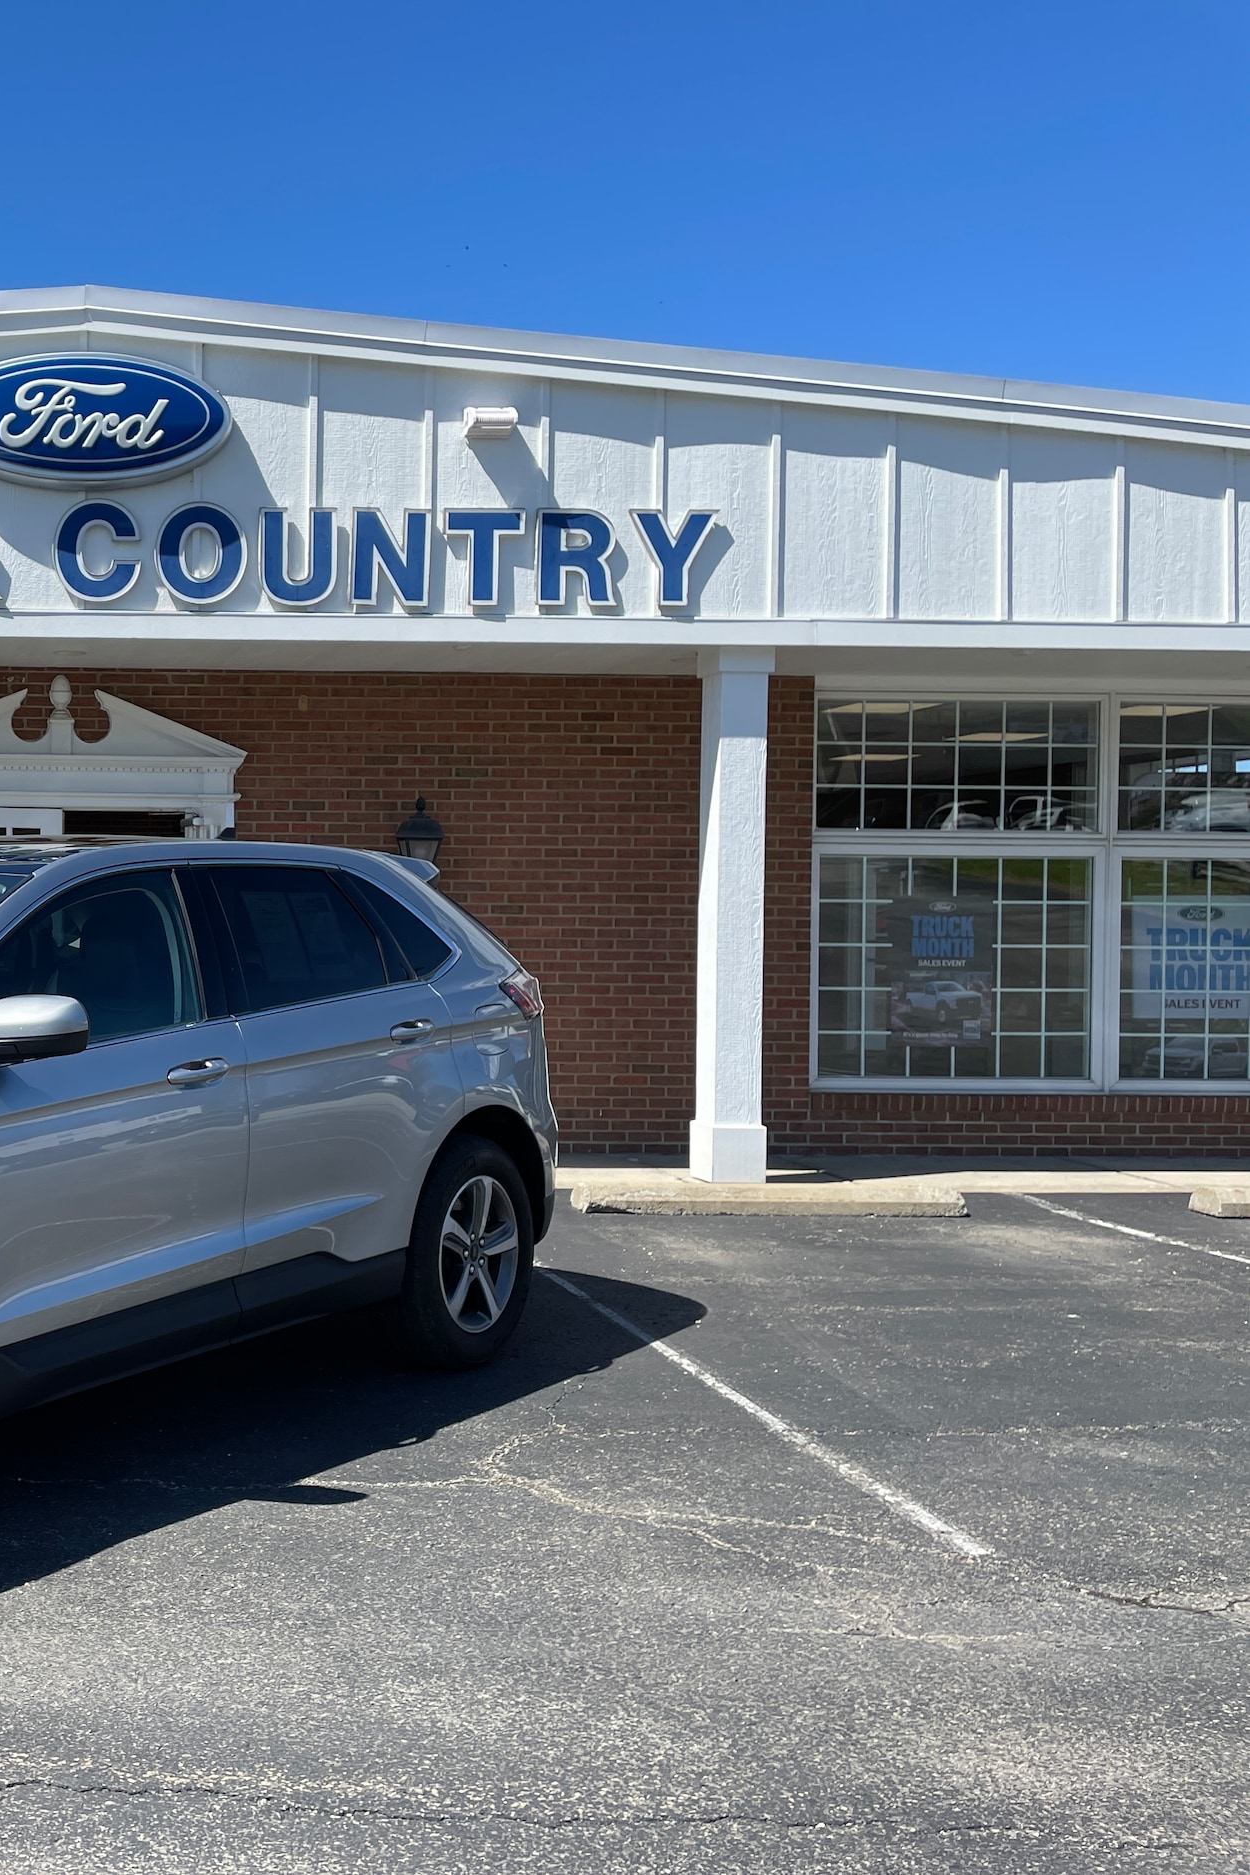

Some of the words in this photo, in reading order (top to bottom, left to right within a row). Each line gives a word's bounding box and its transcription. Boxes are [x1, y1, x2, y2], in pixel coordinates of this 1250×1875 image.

[53, 498, 718, 607] COUNTRY
[910, 915, 974, 937] TRUCK
[911, 937, 974, 958] MONTH
[918, 959, 941, 967] SALES
[942, 959, 966, 967] EVENT
